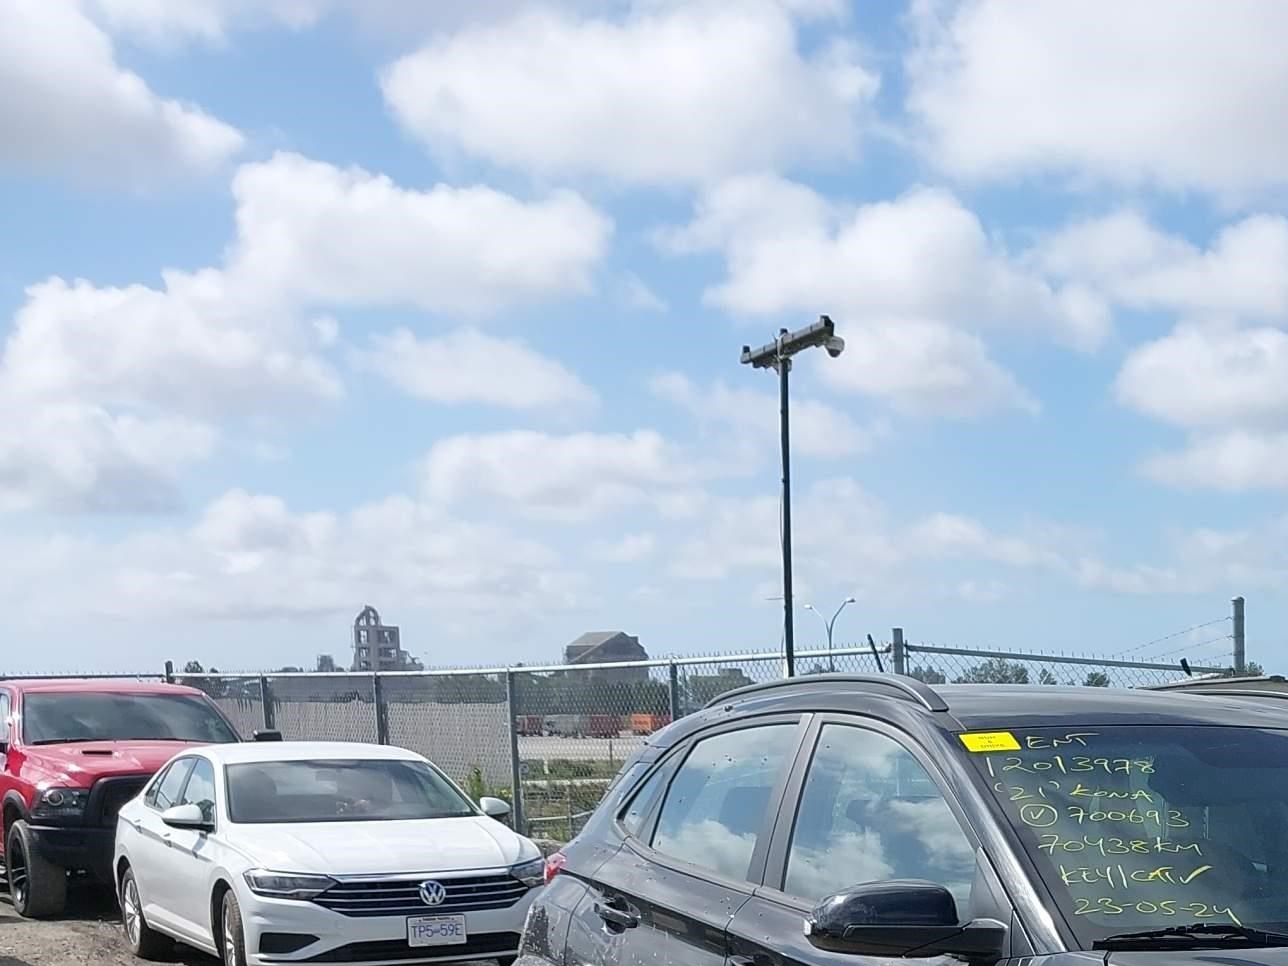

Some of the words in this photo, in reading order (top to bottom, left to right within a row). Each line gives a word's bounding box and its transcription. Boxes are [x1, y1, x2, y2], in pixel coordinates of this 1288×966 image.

[986, 755, 1157, 777] 12013978
[1067, 806, 1190, 828] 700693
[1074, 898, 1242, 927] 23-05-24
